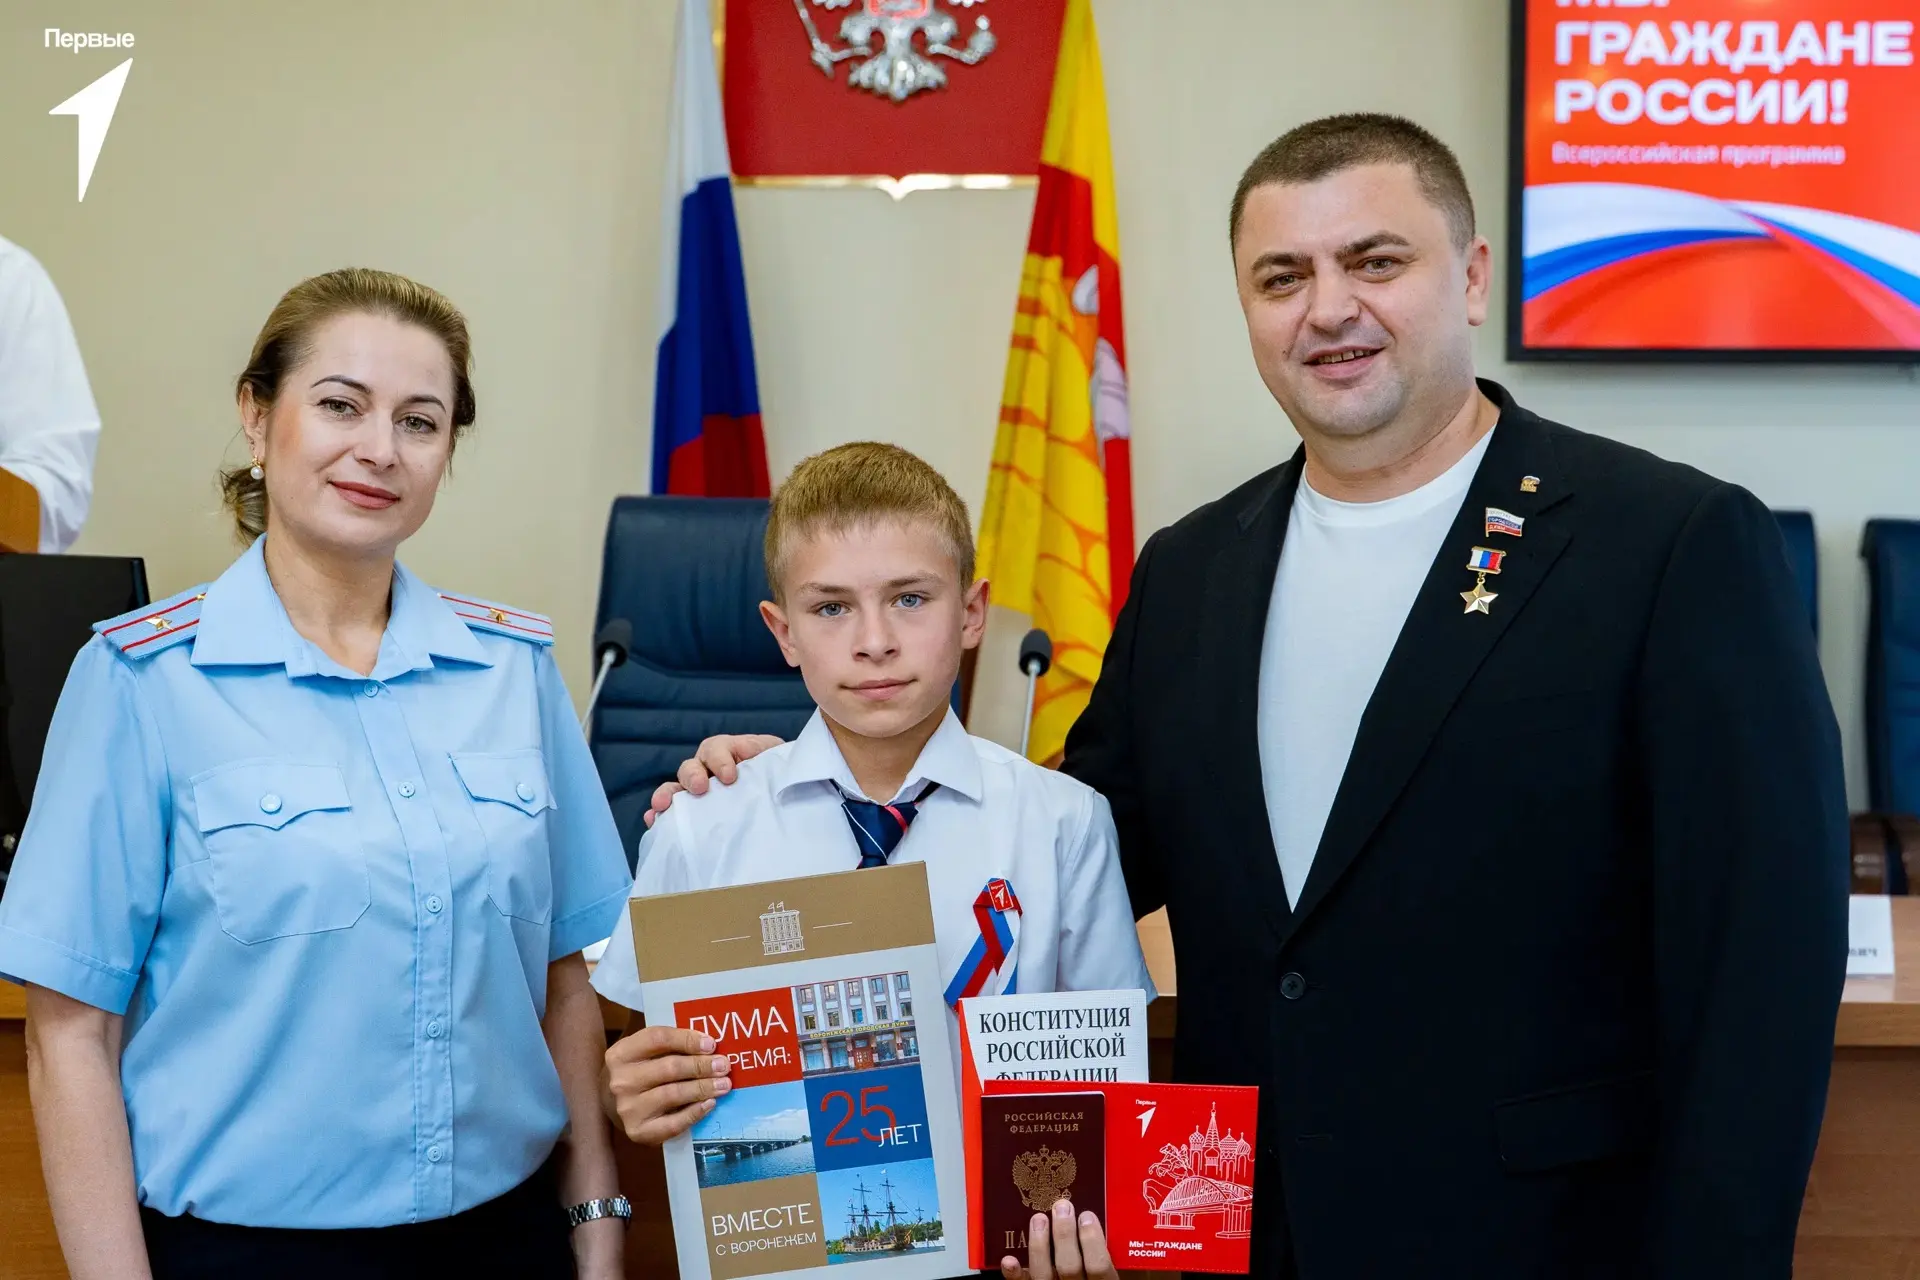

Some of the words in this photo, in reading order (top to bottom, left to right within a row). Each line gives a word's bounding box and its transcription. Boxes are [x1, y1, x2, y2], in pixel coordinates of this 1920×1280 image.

[1555, 20, 1913, 73] ГРАЖДАНЕ
[1554, 79, 1849, 125] РОССИИ!
[979, 1007, 1131, 1034] КОНСТИТУЦИЯ
[727, 1046, 792, 1070] РЕМЯ:
[986, 1032, 1126, 1063] РОССИЙСКОЙ
[820, 1085, 897, 1147] 25
[878, 1123, 922, 1147] ЛЕТ
[1004, 1111, 1084, 1122] РОССИЙСКАЯ
[1009, 1123, 1080, 1134] ФЕДЕРАЦИЯ
[711, 1203, 814, 1236] ВМЕСТЕ
[715, 1244, 727, 1256] С
[730, 1232, 817, 1254] ВОРОНЕЖЕМ
[1128, 1250, 1166, 1258] РОССИИ!
[1129, 1240, 1144, 1248] МЫ
[1154, 1241, 1203, 1250] ГРАЖДАНЕ
